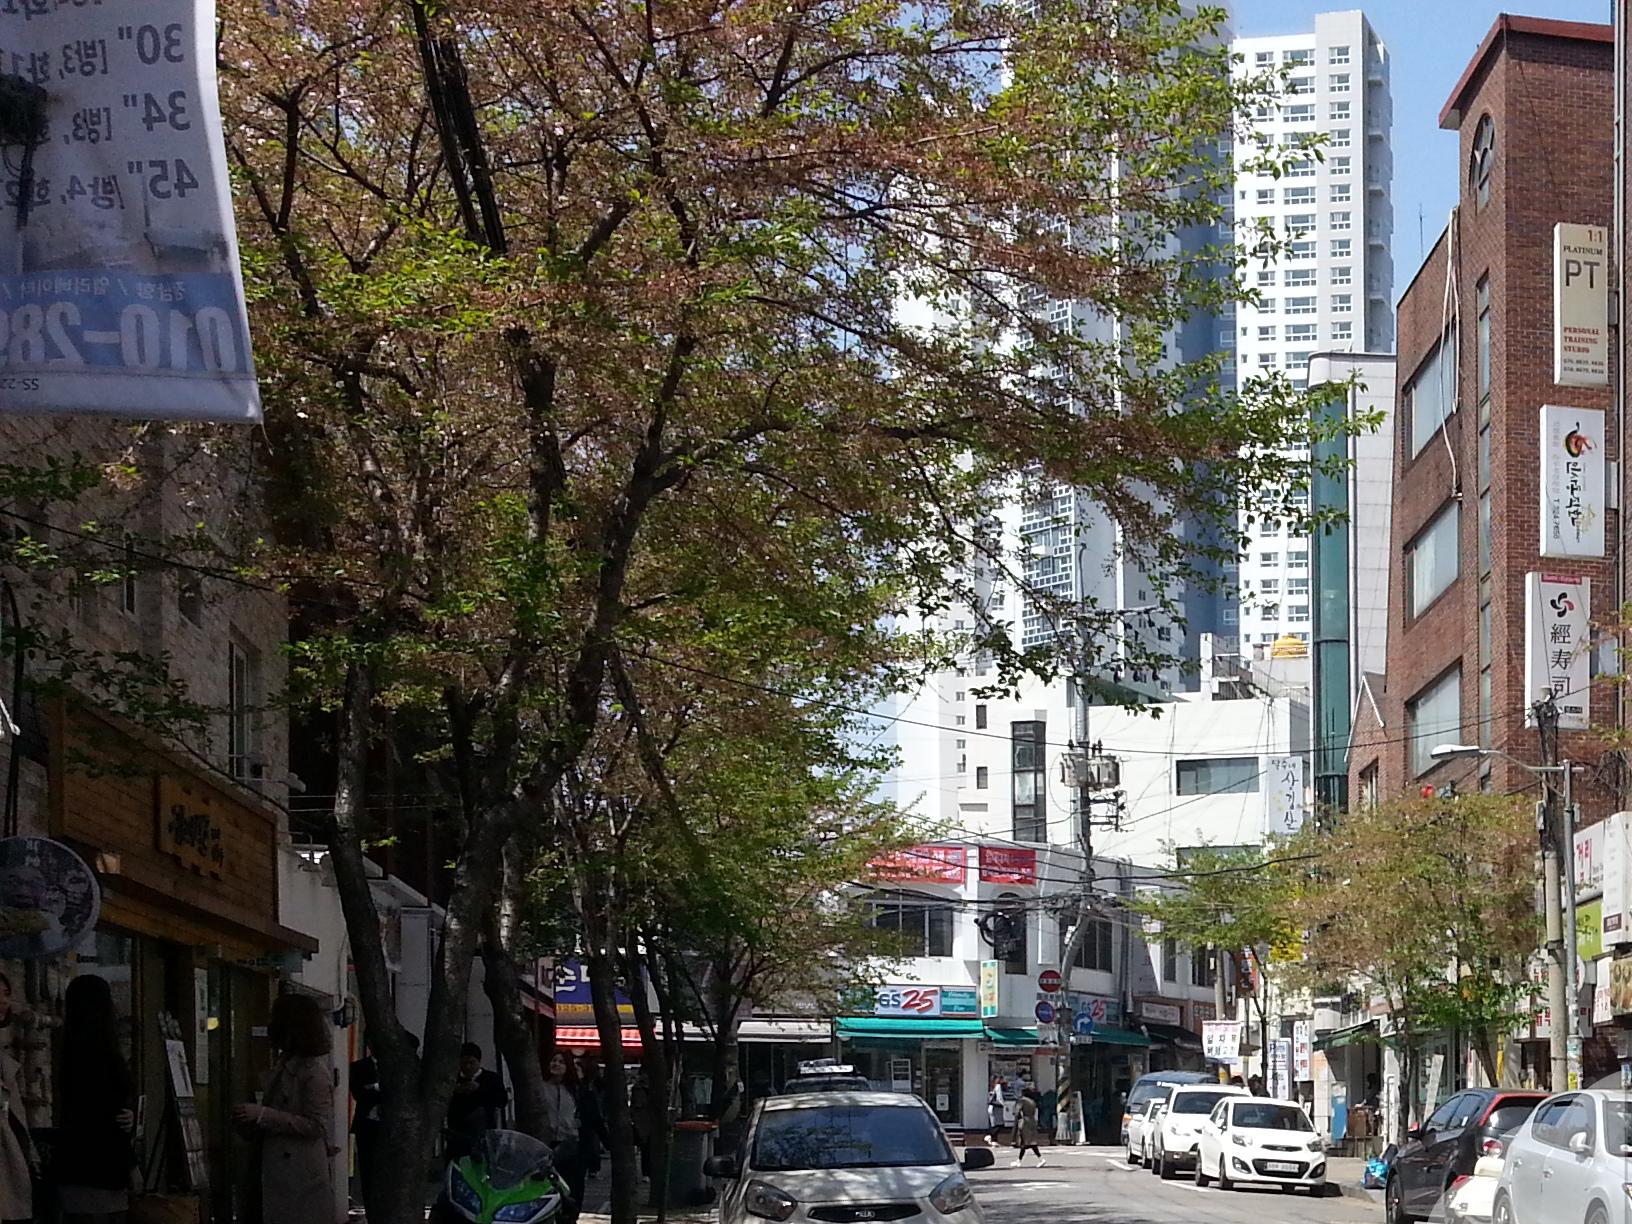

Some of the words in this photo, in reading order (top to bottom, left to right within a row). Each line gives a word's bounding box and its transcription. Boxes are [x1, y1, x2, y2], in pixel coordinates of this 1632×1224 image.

[1587, 229, 1603, 243] 1:1
[1563, 245, 1603, 256] PLATINUM
[1565, 259, 1600, 289] PT
[878, 987, 938, 1013] GS25
